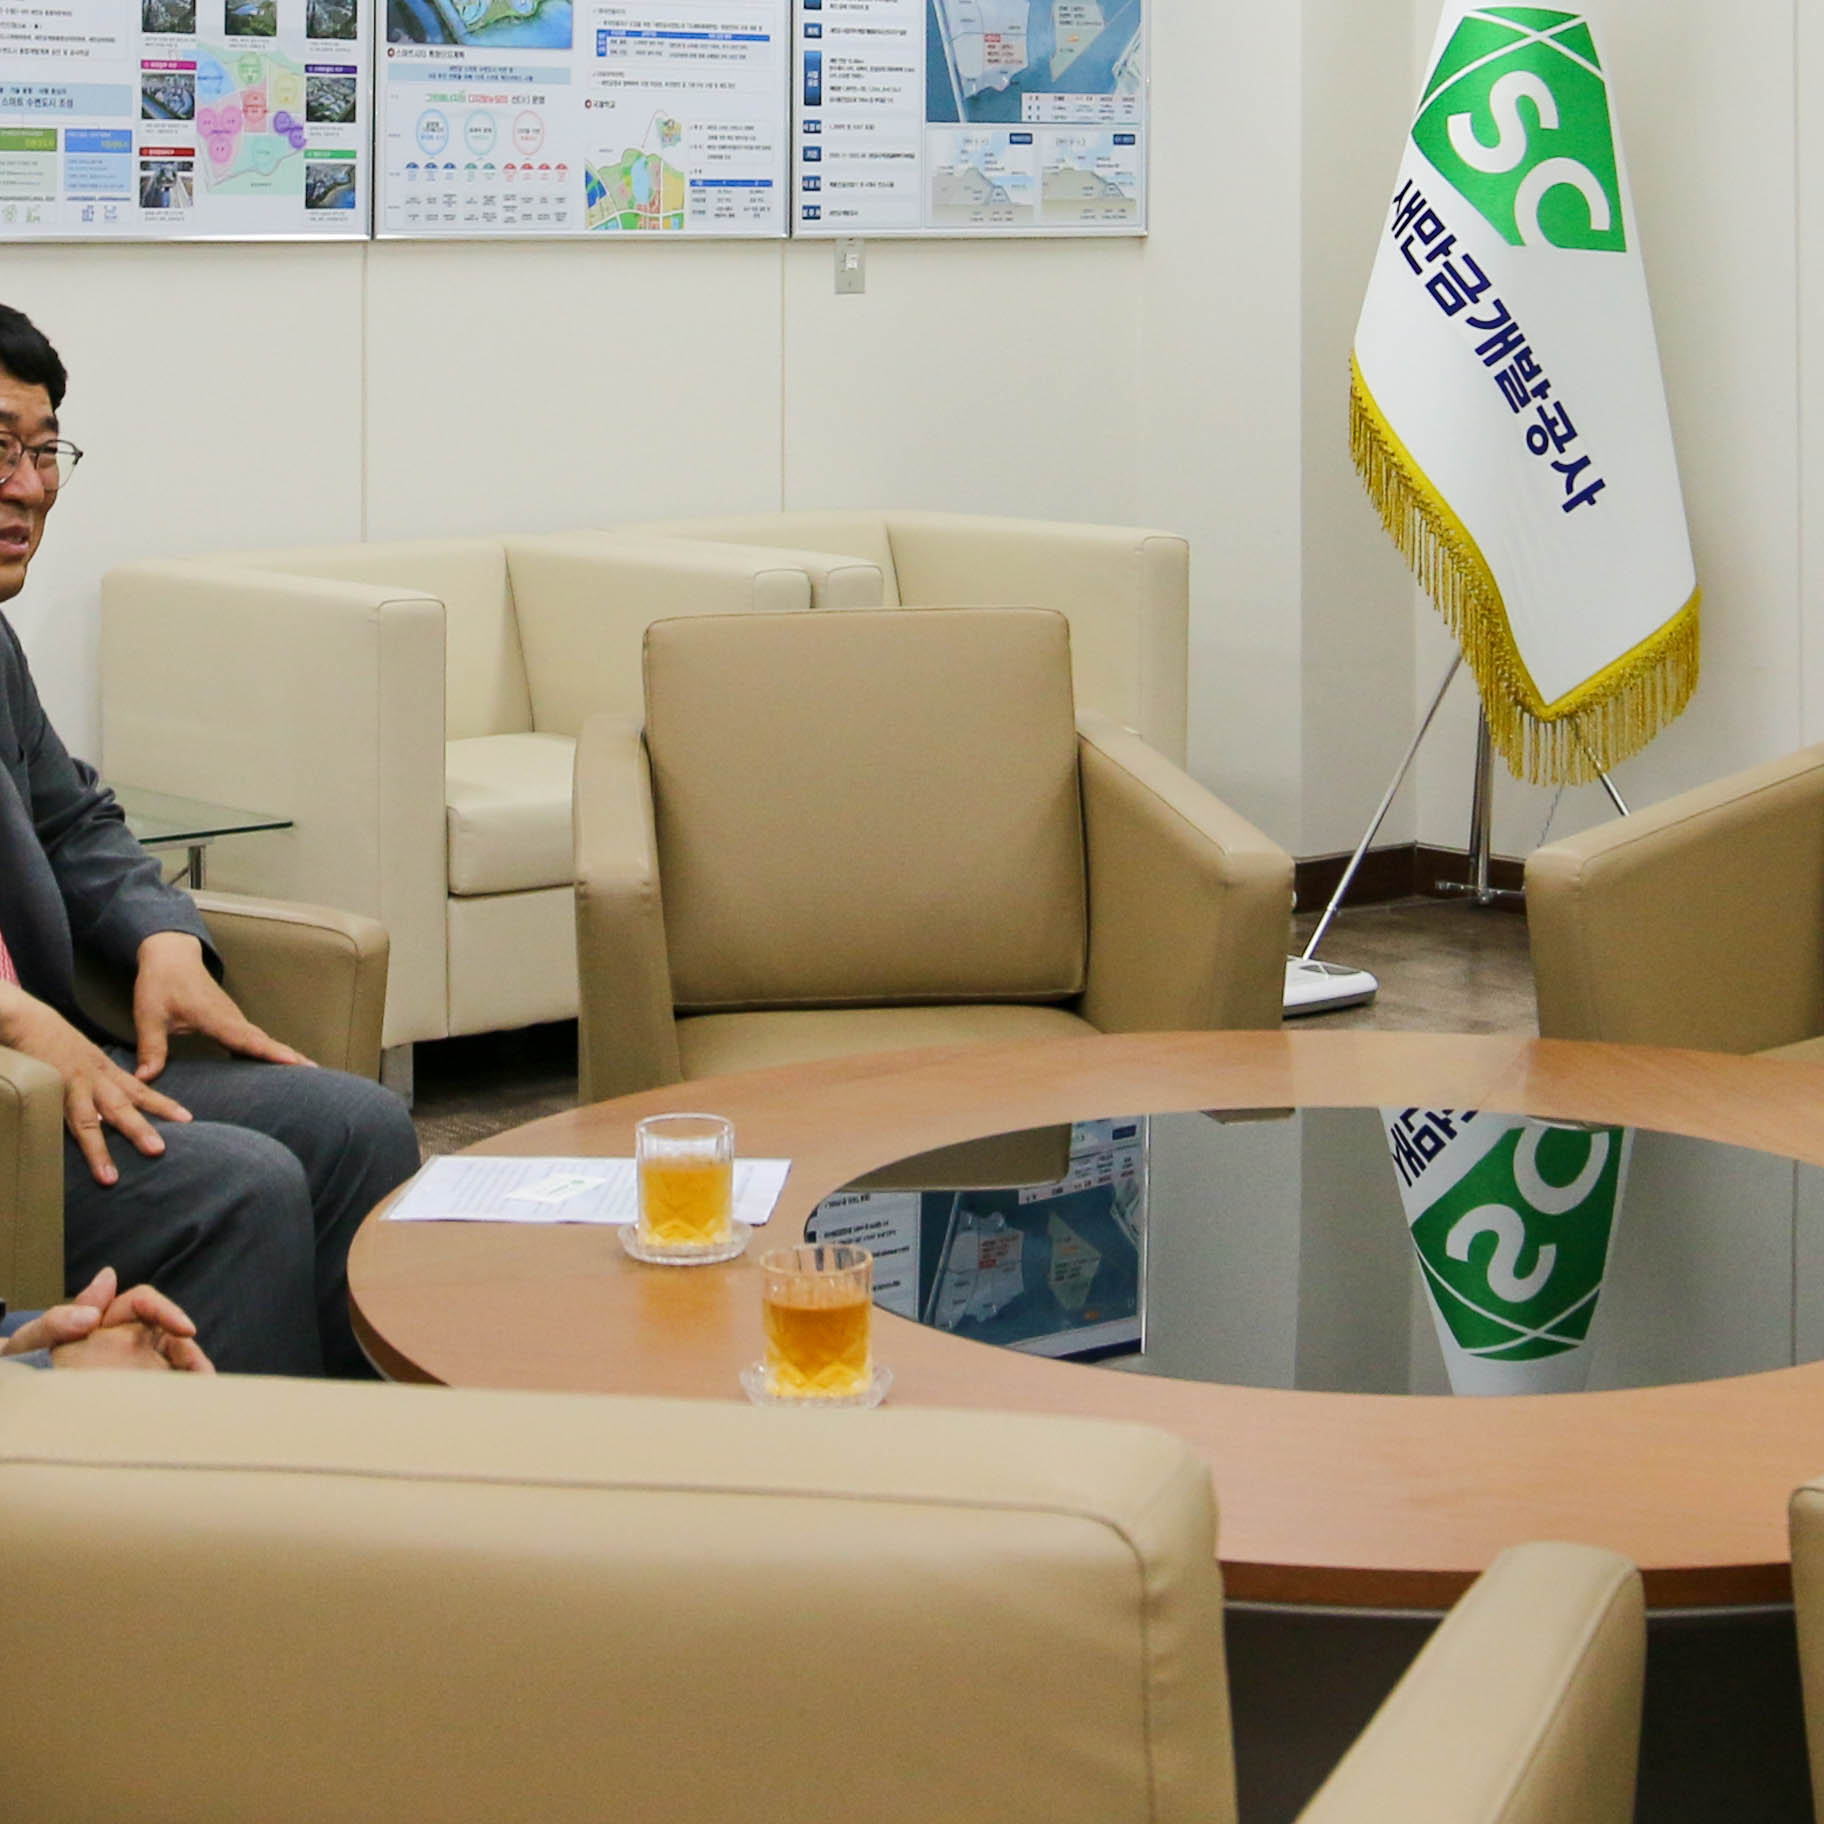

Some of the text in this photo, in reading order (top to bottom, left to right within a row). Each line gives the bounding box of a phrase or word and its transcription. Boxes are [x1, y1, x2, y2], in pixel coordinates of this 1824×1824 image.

[2, 97, 23, 108] 스마트
[26, 97, 57, 108] 수변도시
[59, 98, 73, 108] 조성
[1447, 70, 1611, 249] SC
[1392, 178, 1607, 514] 새만금개발공사
